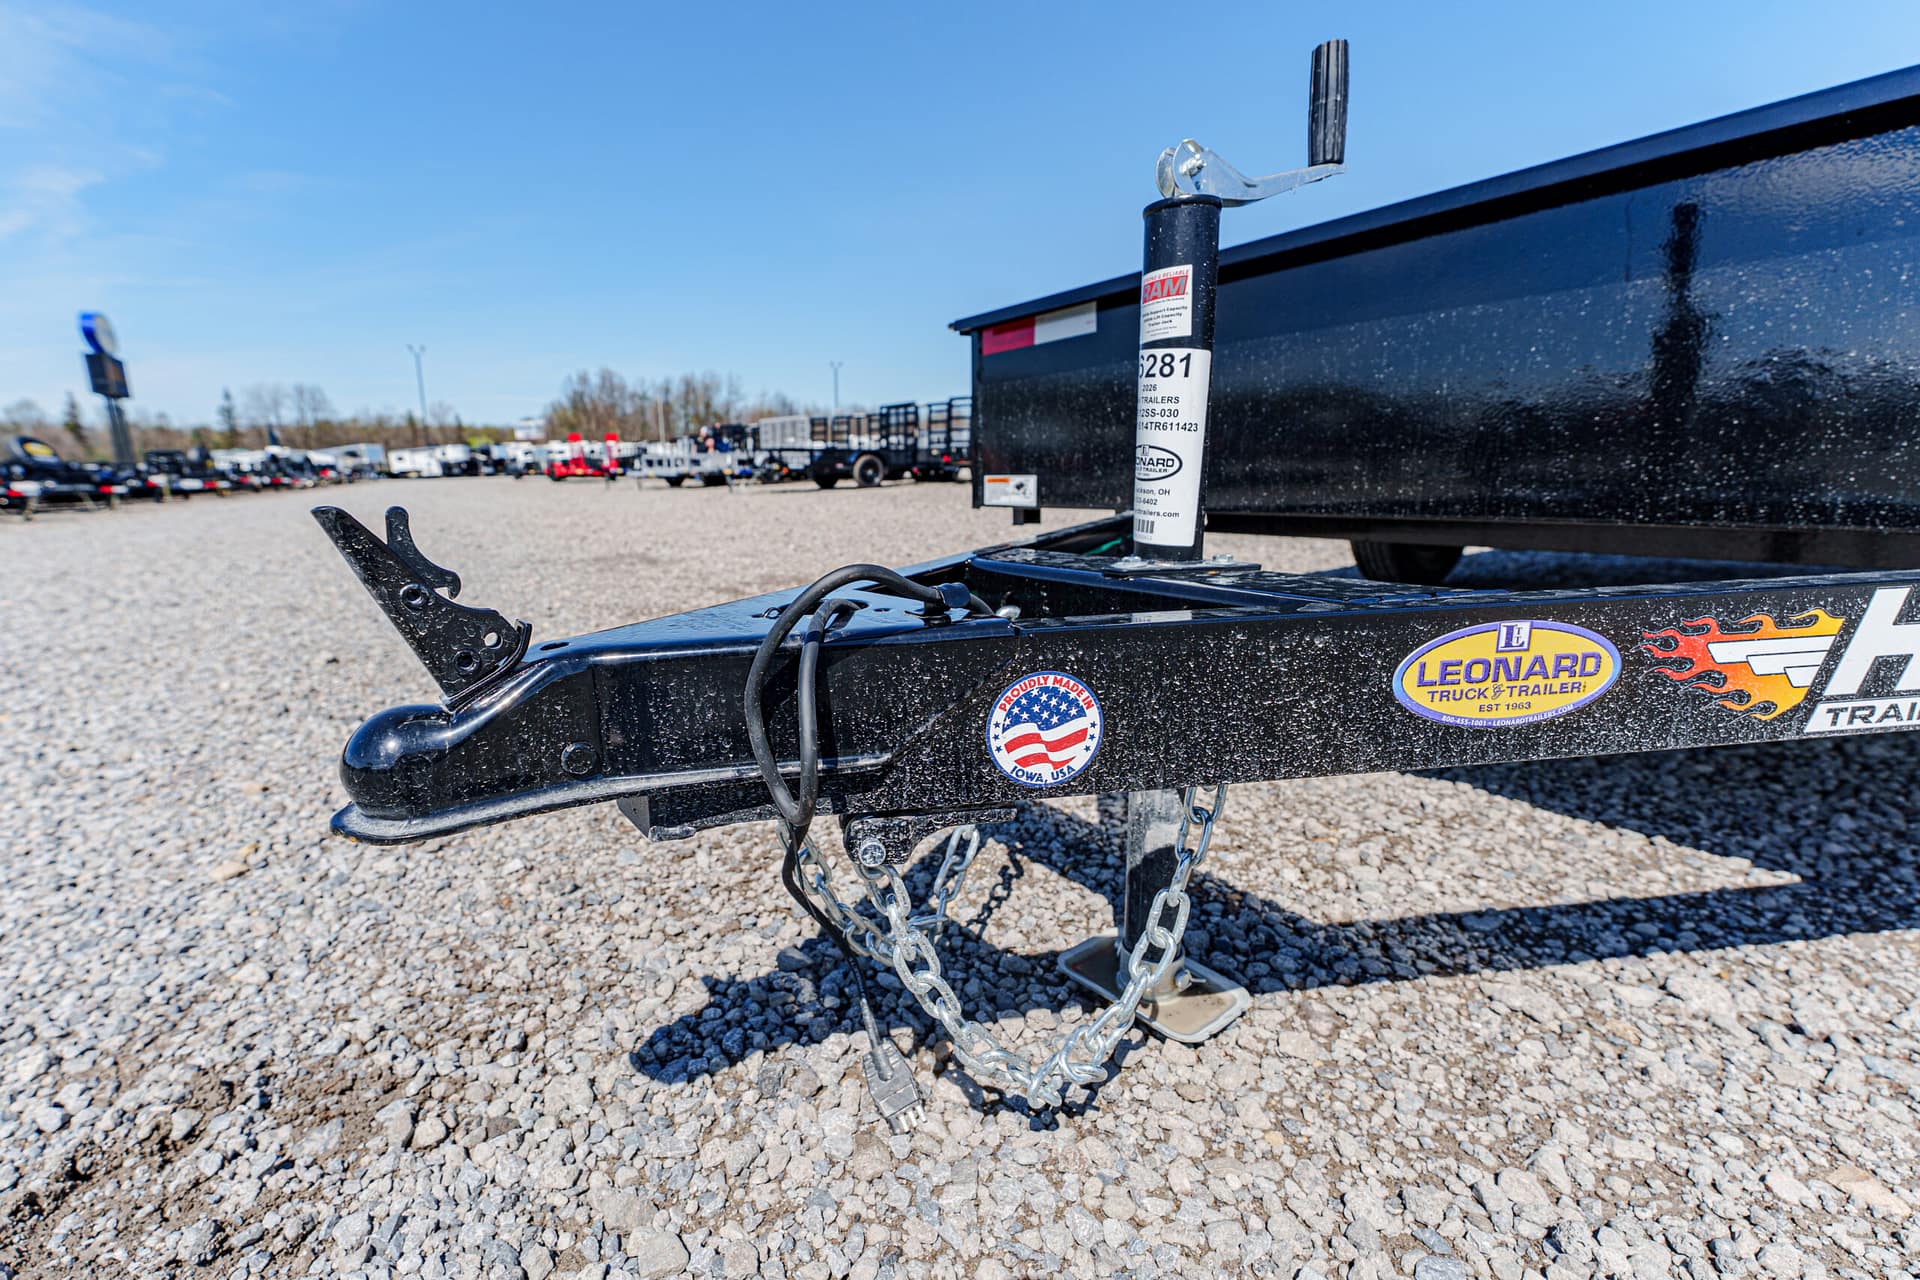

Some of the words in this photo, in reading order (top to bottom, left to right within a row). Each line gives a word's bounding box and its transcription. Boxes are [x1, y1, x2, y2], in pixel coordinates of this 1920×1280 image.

[1143, 277, 1186, 301] RAM
[1141, 396, 1180, 404] TRAILERS
[1416, 652, 1602, 687] LEONARD
[998, 676, 1050, 712] PROUDLY
[1052, 676, 1086, 697] MADE
[1081, 694, 1095, 711] IN
[1427, 686, 1488, 702] TRUCK
[1506, 681, 1582, 698] TRAILER
[1478, 703, 1500, 713] EST
[1505, 701, 1532, 711] 1963
[1492, 704, 1574, 727] LEONARDTRAILERS.COM
[1010, 765, 1049, 785] IOWA,
[1050, 764, 1077, 781] USA
